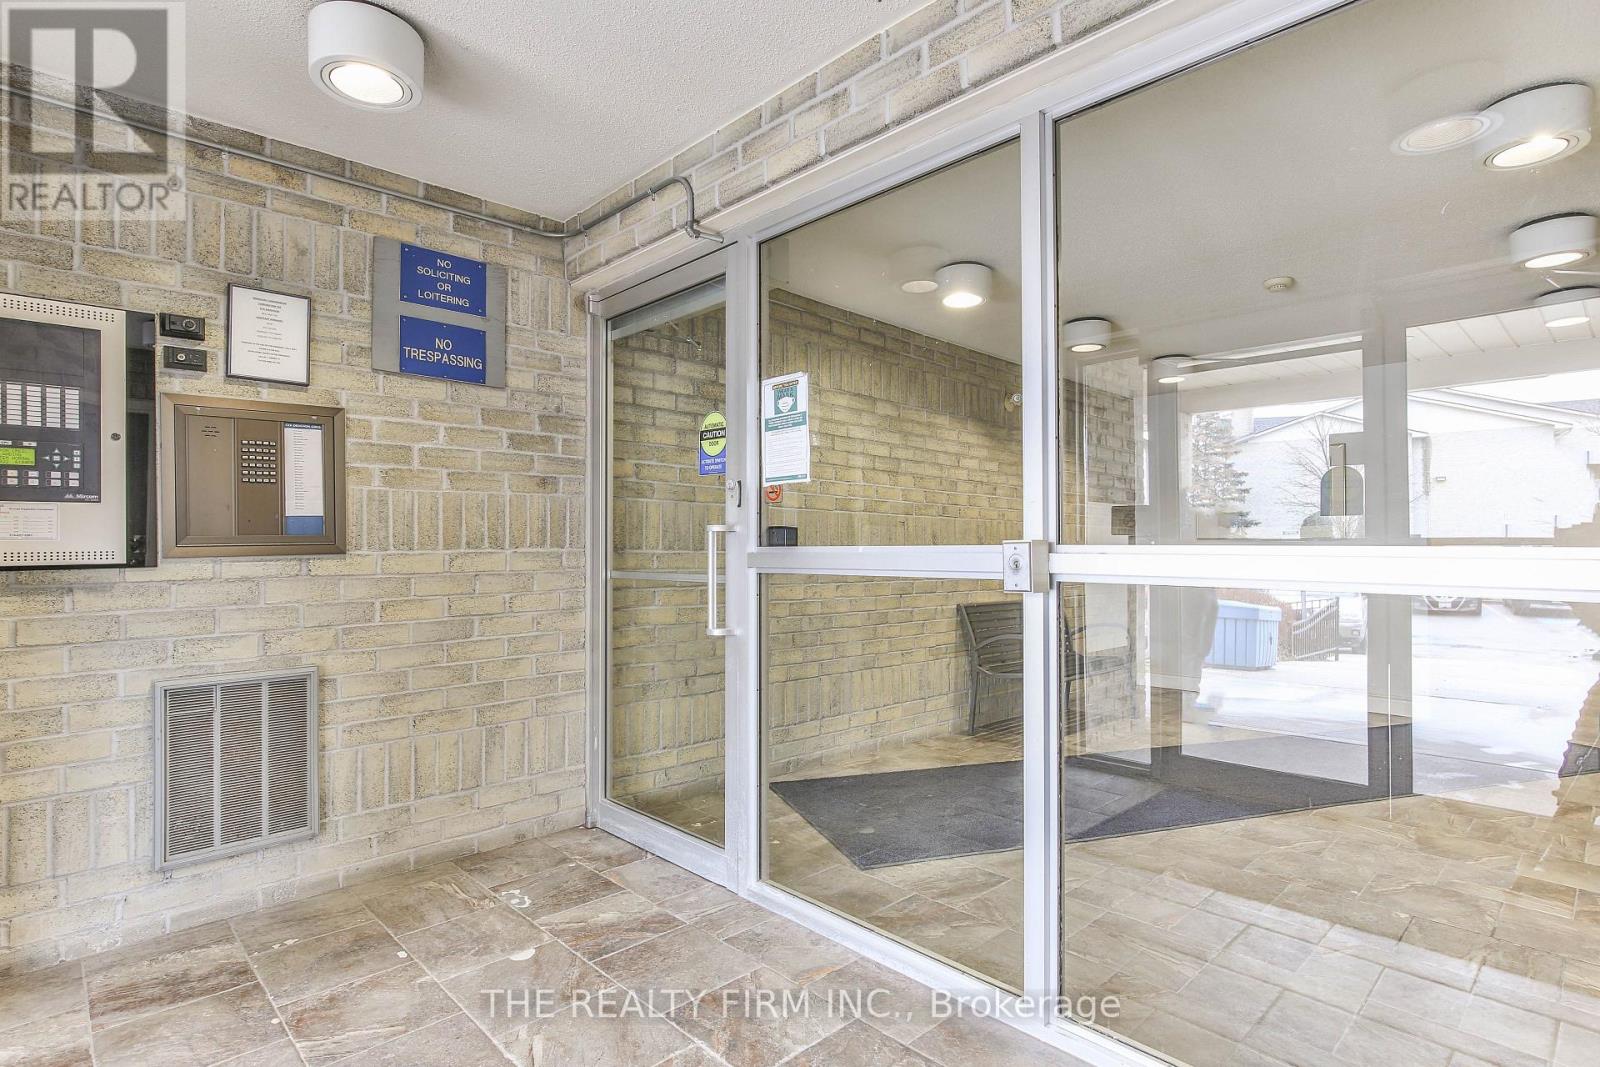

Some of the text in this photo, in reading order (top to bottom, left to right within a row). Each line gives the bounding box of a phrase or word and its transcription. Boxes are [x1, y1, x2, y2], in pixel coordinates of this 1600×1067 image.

[436, 258, 452, 269] NO
[416, 265, 471, 285] SOLICITING
[436, 282, 452, 292] OR
[417, 289, 470, 307] LOITERING
[435, 337, 453, 351] NO
[403, 346, 483, 370] TRESPASSING
[702, 429, 726, 439] CAUTION
